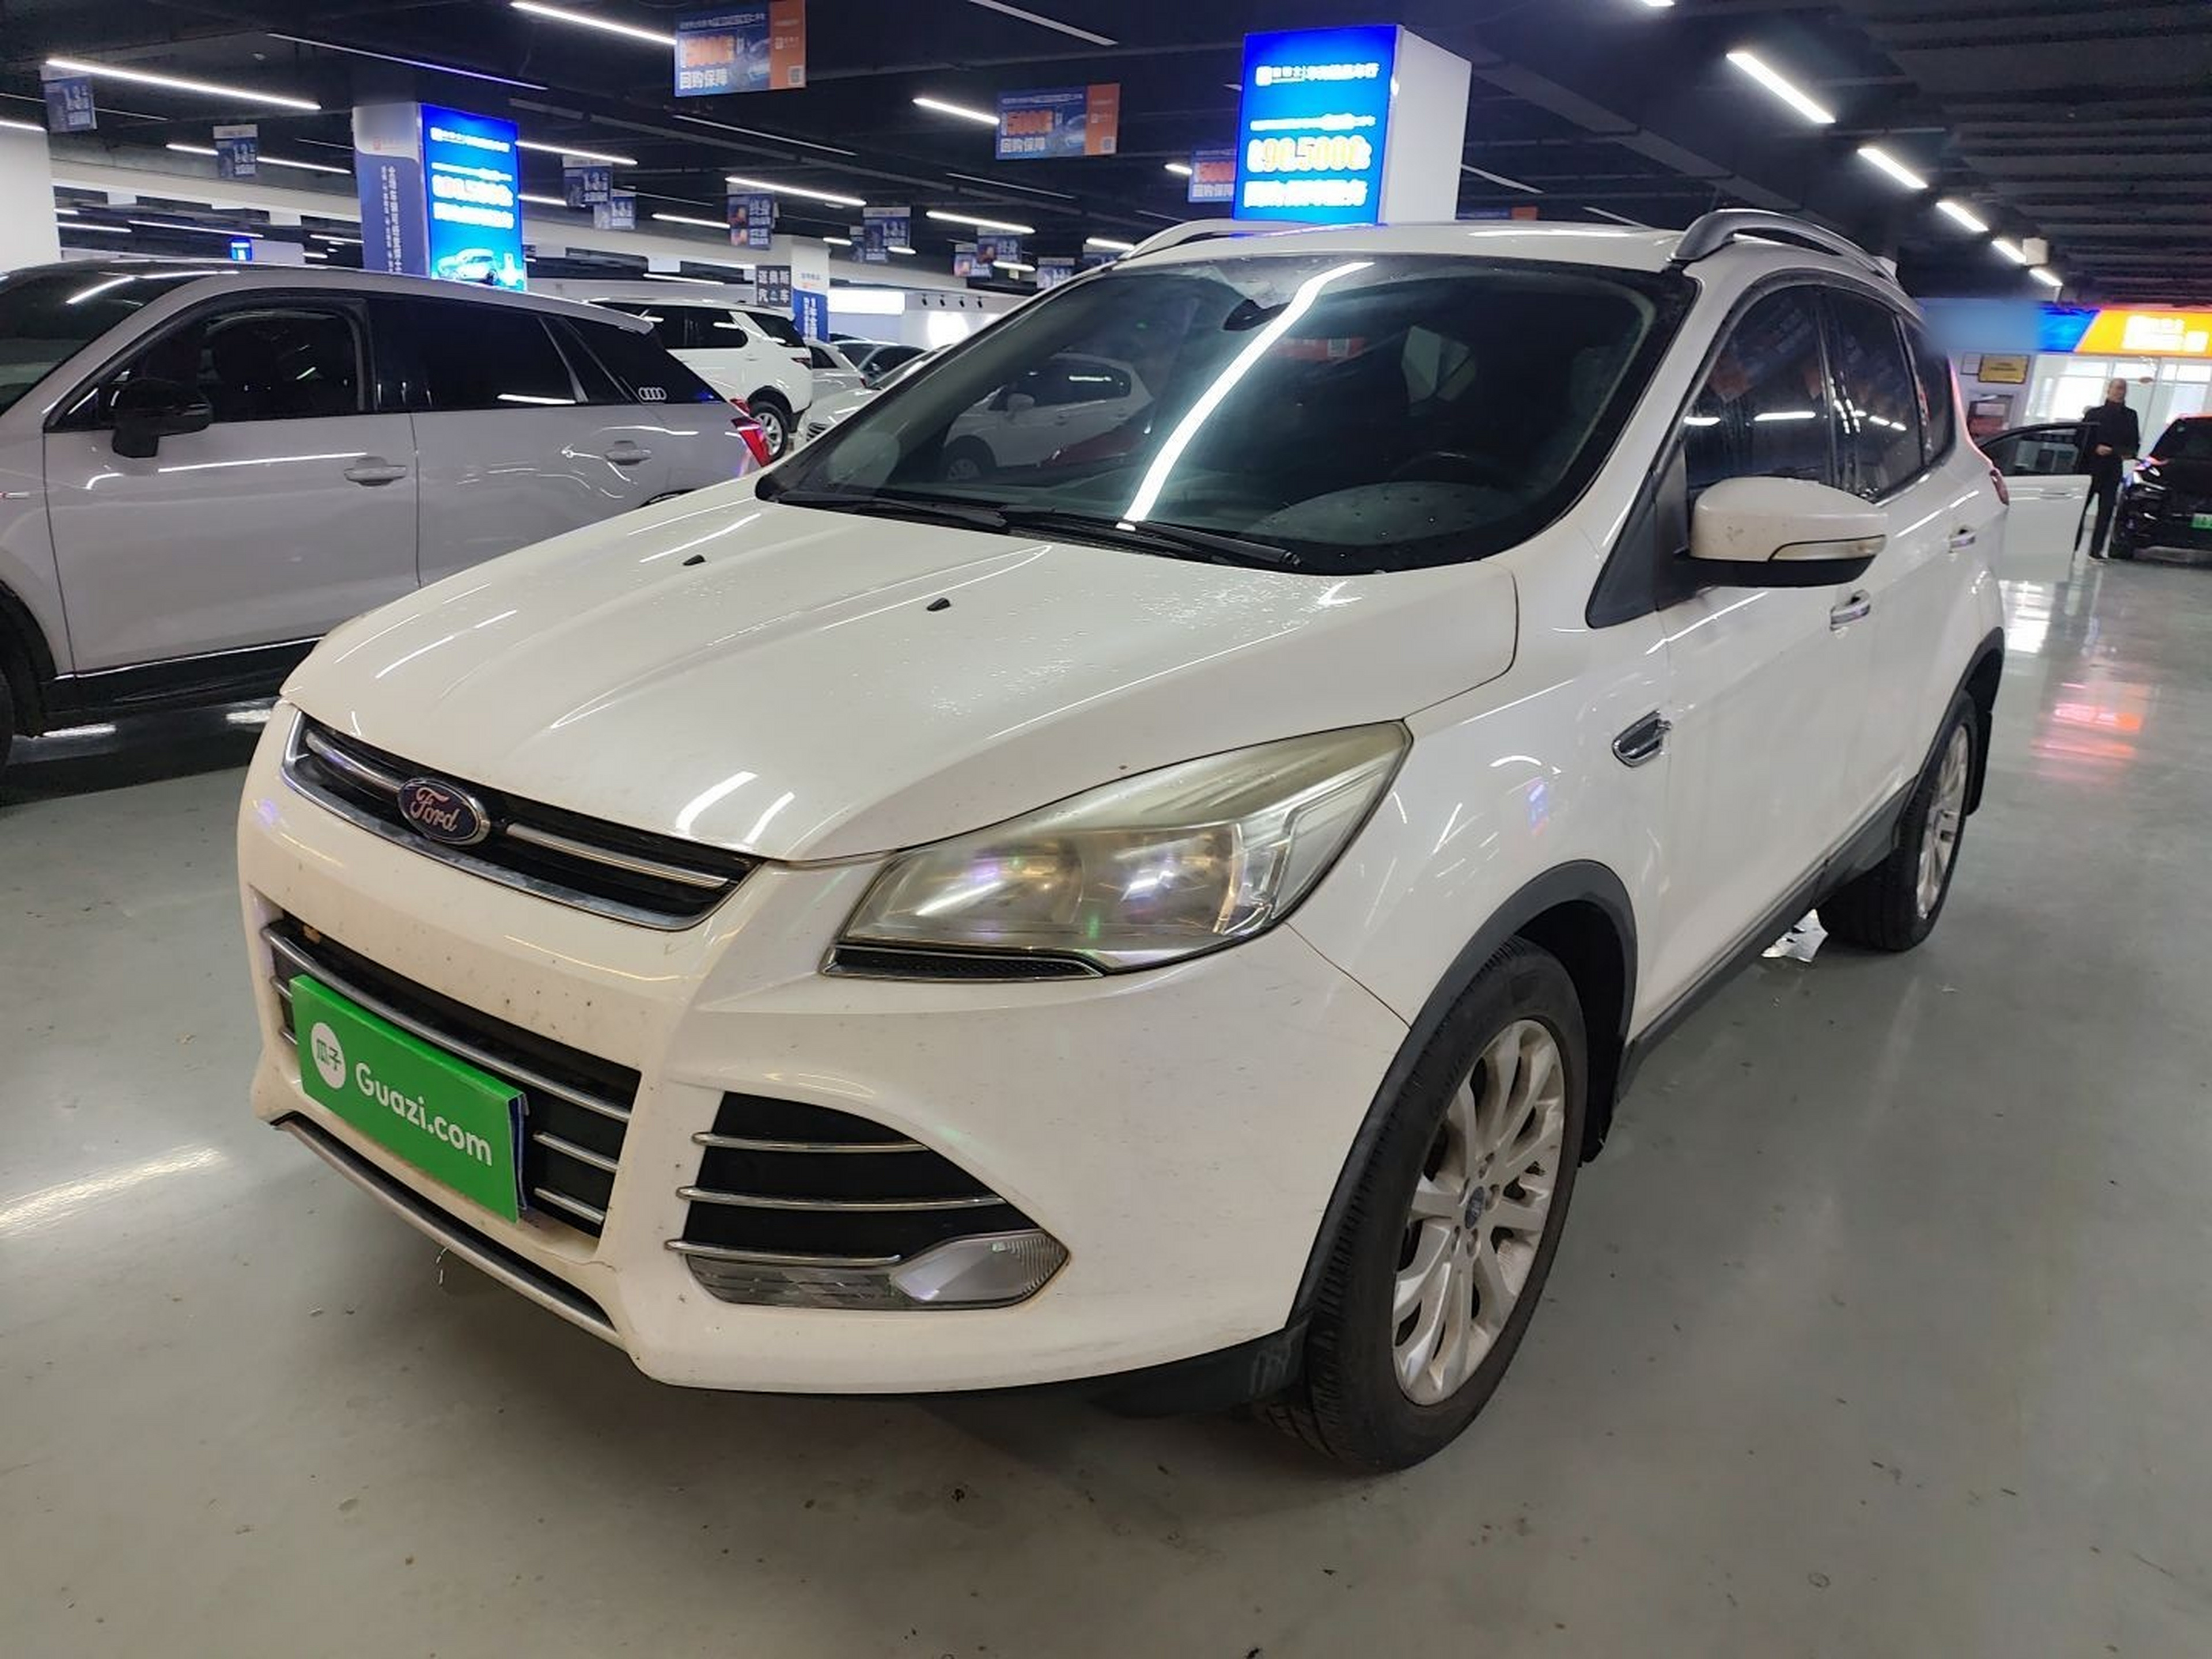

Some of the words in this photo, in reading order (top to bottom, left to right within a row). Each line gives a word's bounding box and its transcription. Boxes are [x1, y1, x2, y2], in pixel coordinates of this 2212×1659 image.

[410, 787, 461, 831] Ford
[316, 1038, 342, 1071] 瓜子
[355, 1062, 493, 1166] Guazi.com
